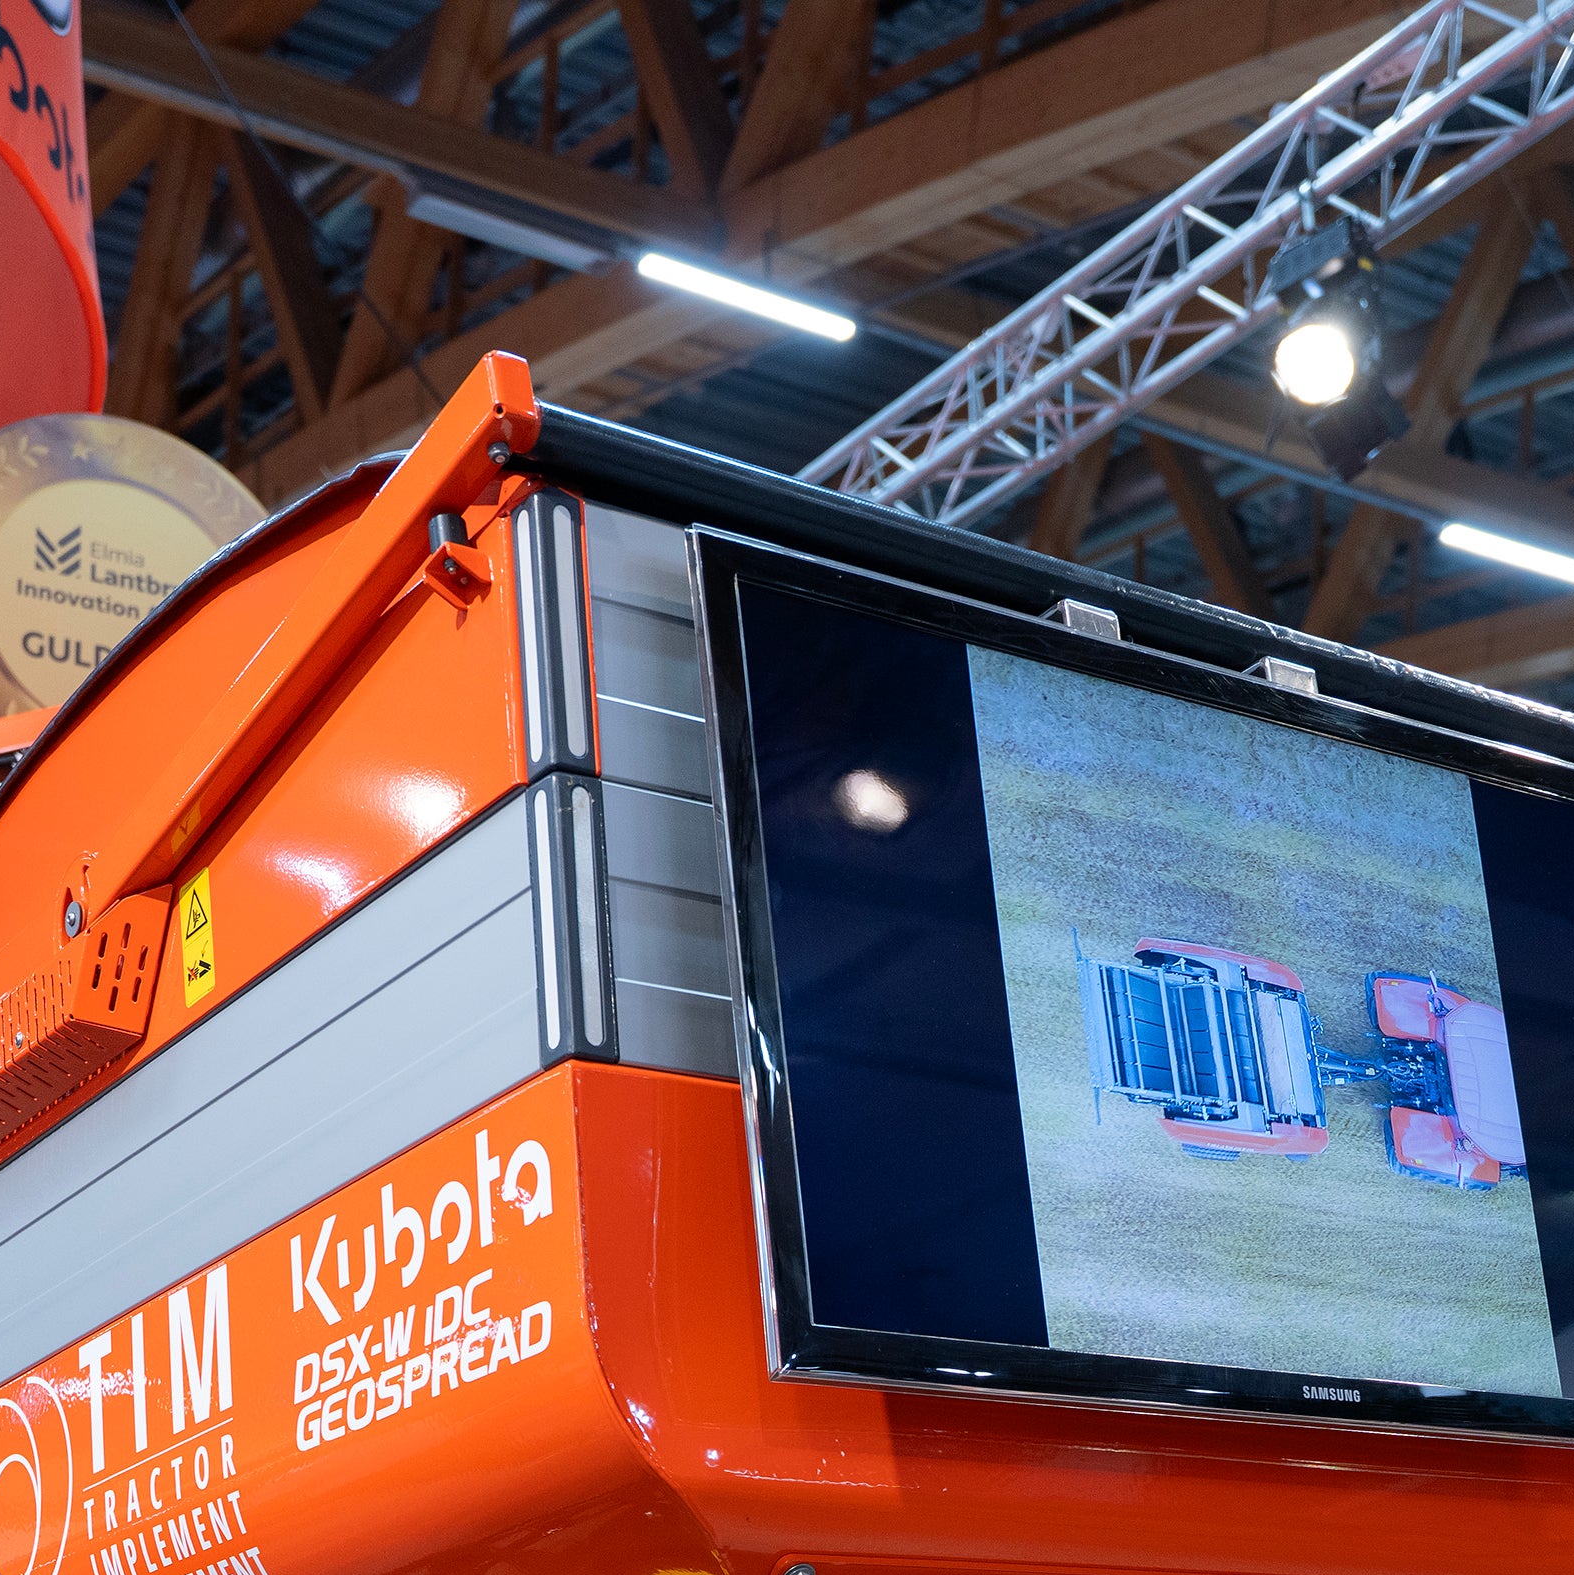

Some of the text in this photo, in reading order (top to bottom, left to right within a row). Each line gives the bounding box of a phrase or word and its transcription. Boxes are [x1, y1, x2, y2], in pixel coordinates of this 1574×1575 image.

[16, 578, 140, 620] Innovation
[90, 541, 144, 568] Elmia
[292, 1129, 553, 1326] Kubota
[78, 1263, 234, 1474] TIM
[294, 1309, 415, 1406] DSX-W
[295, 1300, 553, 1452] GEOSPREAD
[1302, 1385, 1361, 1403] SAMSUNG
[82, 1432, 239, 1541] TRACTOR
